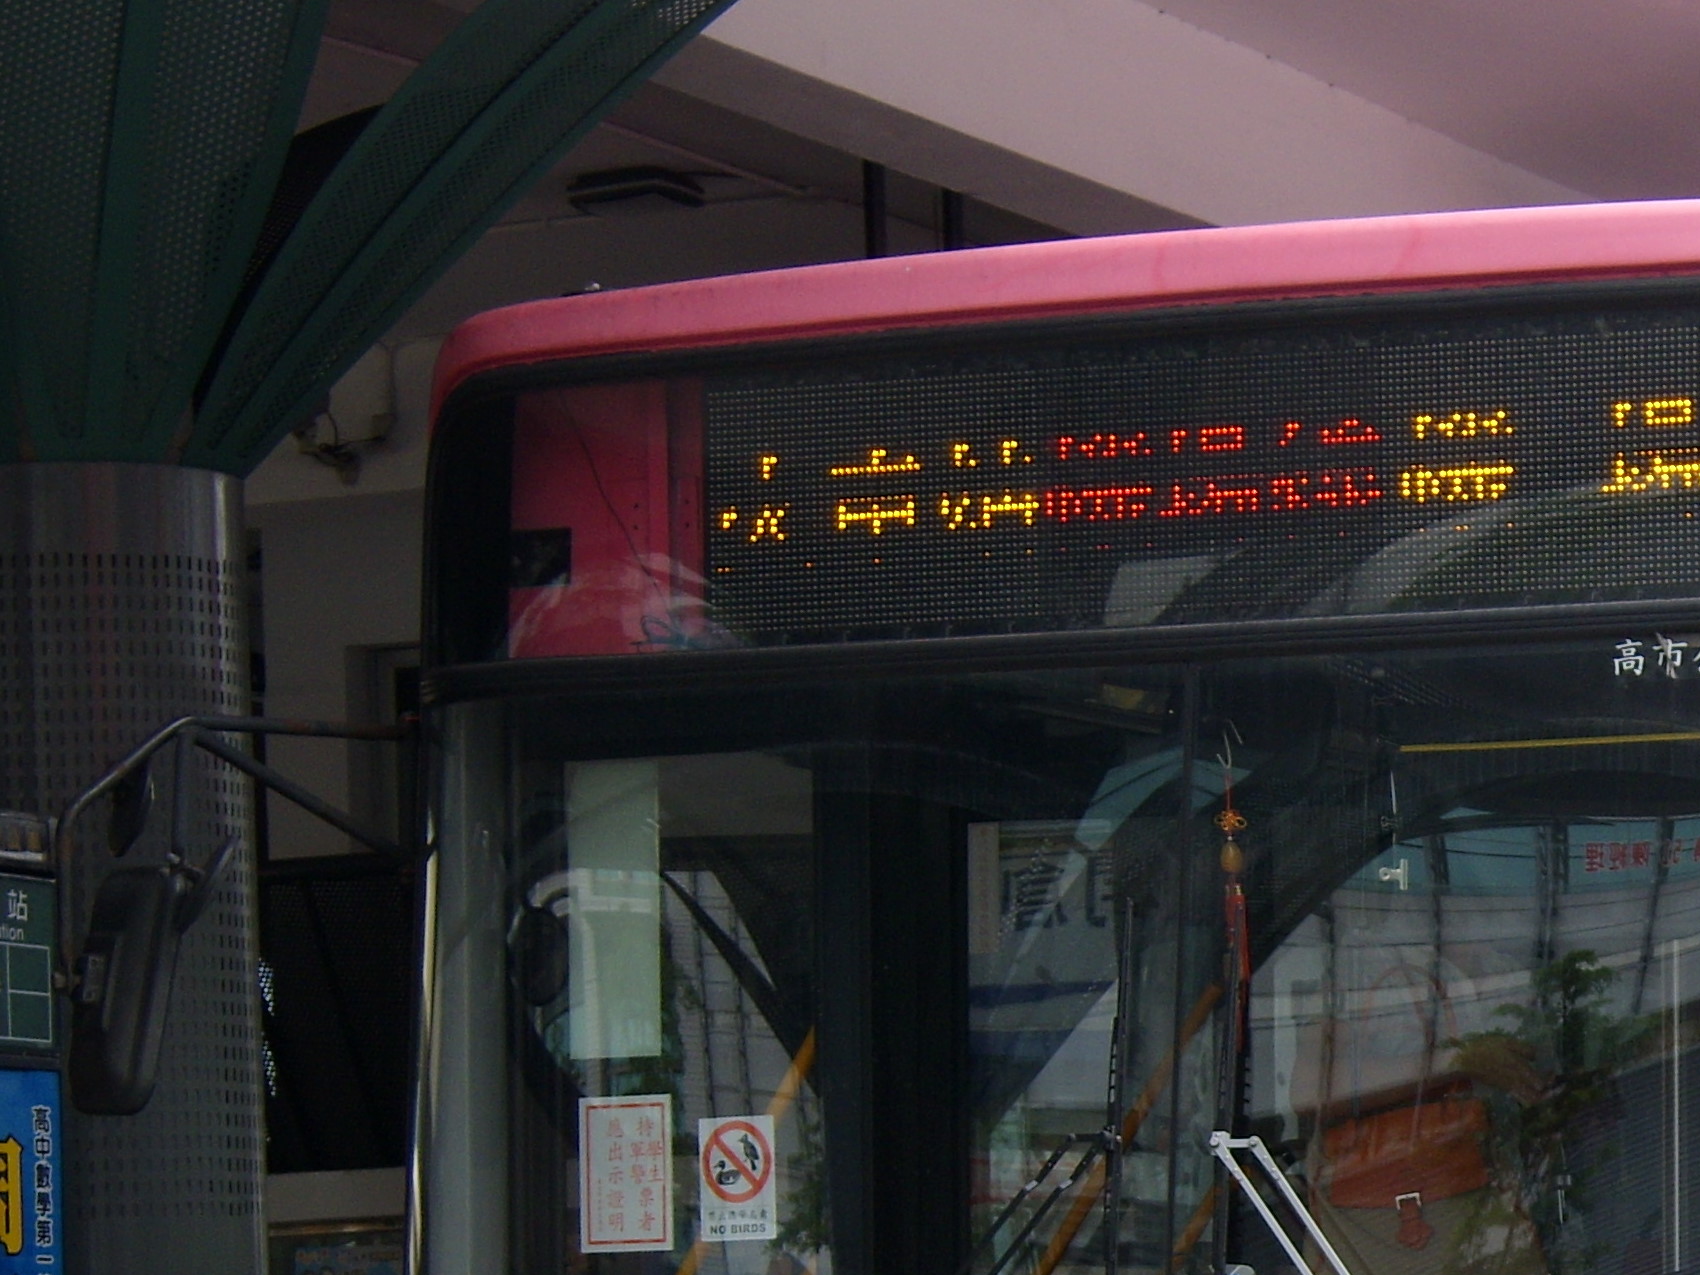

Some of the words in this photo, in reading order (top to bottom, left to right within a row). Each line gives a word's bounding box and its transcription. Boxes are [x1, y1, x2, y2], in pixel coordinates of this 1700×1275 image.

[7, 888, 28, 921] 站
[710, 1224, 727, 1235] NO
[730, 1222, 767, 1234] BIRDS
